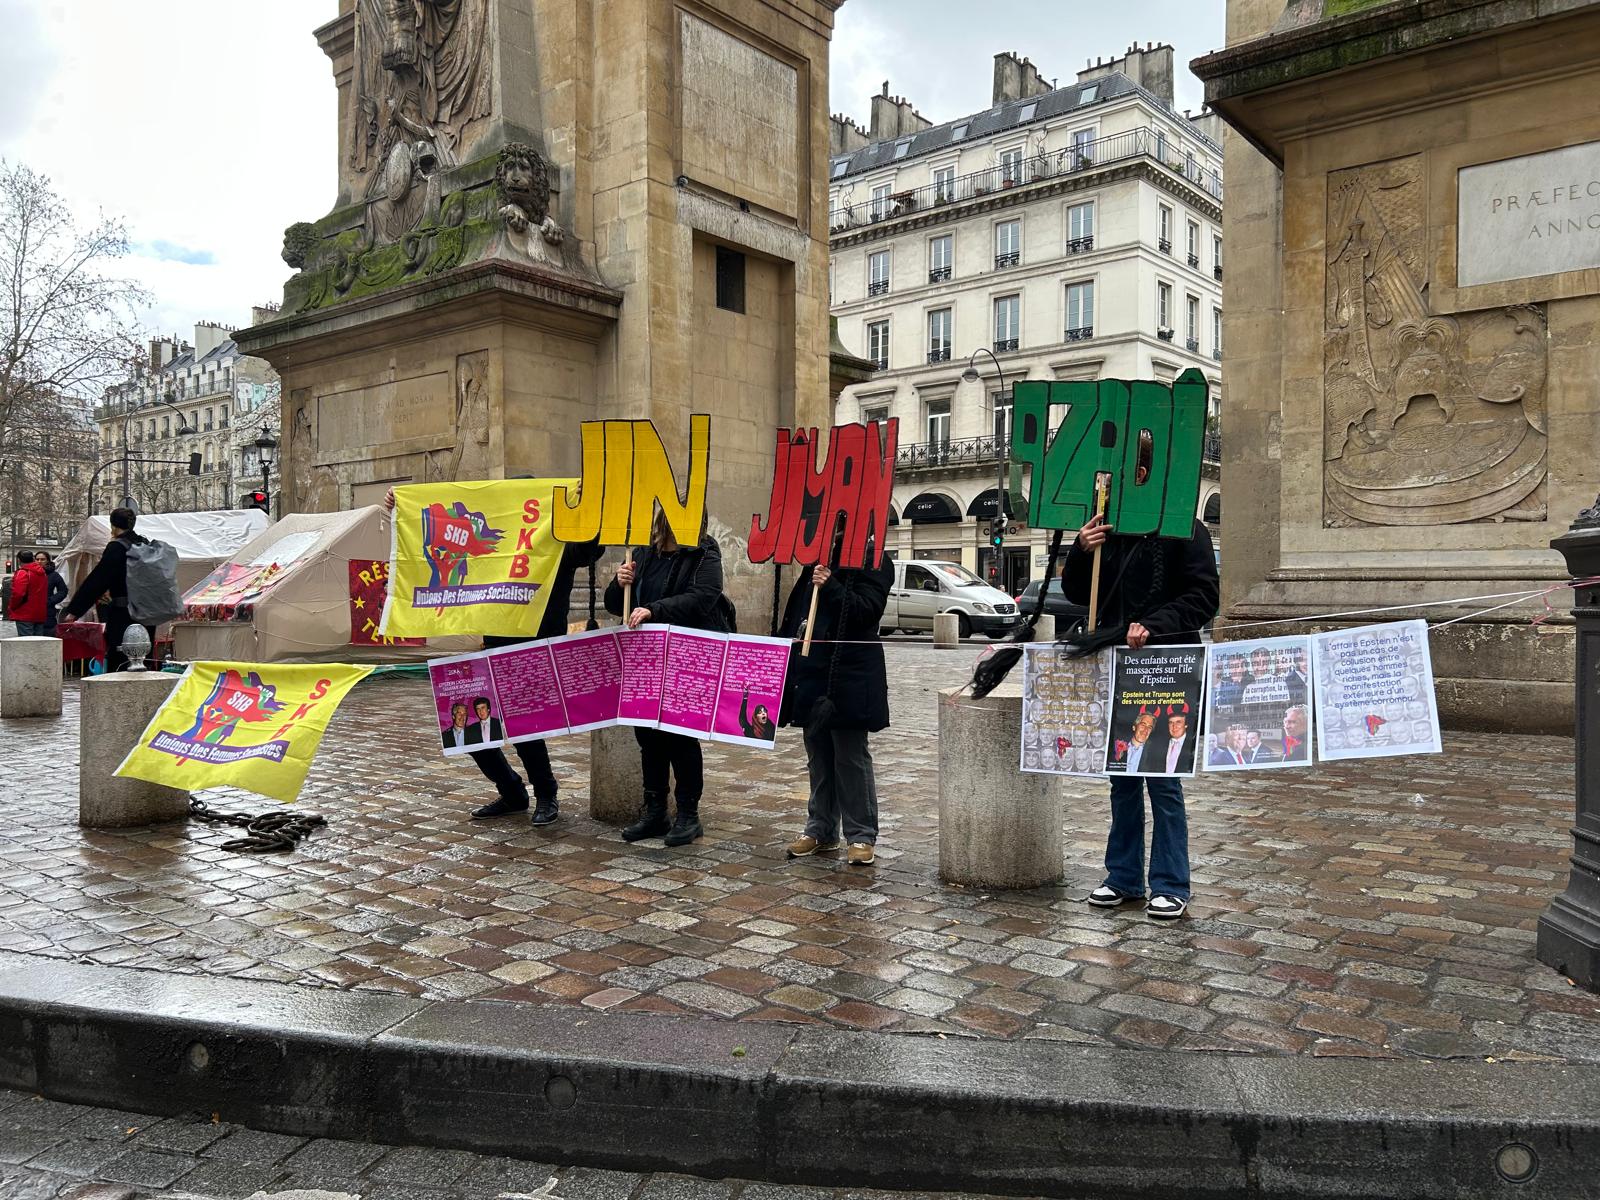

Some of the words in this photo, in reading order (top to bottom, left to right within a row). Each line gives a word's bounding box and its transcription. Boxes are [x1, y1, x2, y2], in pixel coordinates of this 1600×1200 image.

[551, 414, 711, 548] JIN
[444, 523, 469, 546] SKB
[486, 585, 539, 601] Socialiste
[1324, 641, 1359, 652] L'affaire
[1360, 637, 1391, 647] Epstein
[1393, 634, 1414, 643] n'est
[1340, 650, 1356, 659] pas
[1358, 648, 1368, 656] un
[1369, 646, 1385, 654] cas
[1387, 645, 1399, 653] de
[1124, 655, 1139, 665] Des
[1140, 655, 1168, 665] enfants
[1169, 655, 1182, 664] ont
[1183, 654, 1196, 664] été
[1341, 656, 1376, 667] collusion
[1377, 654, 1400, 663] entre
[1126, 665, 1163, 675] massacrés
[1164, 666, 1177, 674] sur
[1334, 665, 1371, 677] quelques
[1373, 661, 1408, 671] hommes
[1140, 675, 1176, 686] d'Epstein.
[1342, 673, 1370, 683] riches,
[1371, 671, 1391, 680] mais
[1251, 685, 1276, 695] corruption,
[1343, 679, 1402, 691] manifestation
[1122, 691, 1144, 699] Epstein
[1152, 691, 1171, 699] Trump
[1245, 694, 1260, 702] contre
[1269, 692, 1289, 701] femmes
[1343, 689, 1385, 700] extérieure
[1386, 686, 1405, 695] d'un
[226, 691, 254, 712] SKB
[1334, 698, 1370, 710] système
[1371, 695, 1415, 705] corrompu.
[154, 733, 190, 755] Unions
[189, 742, 210, 759] Des
